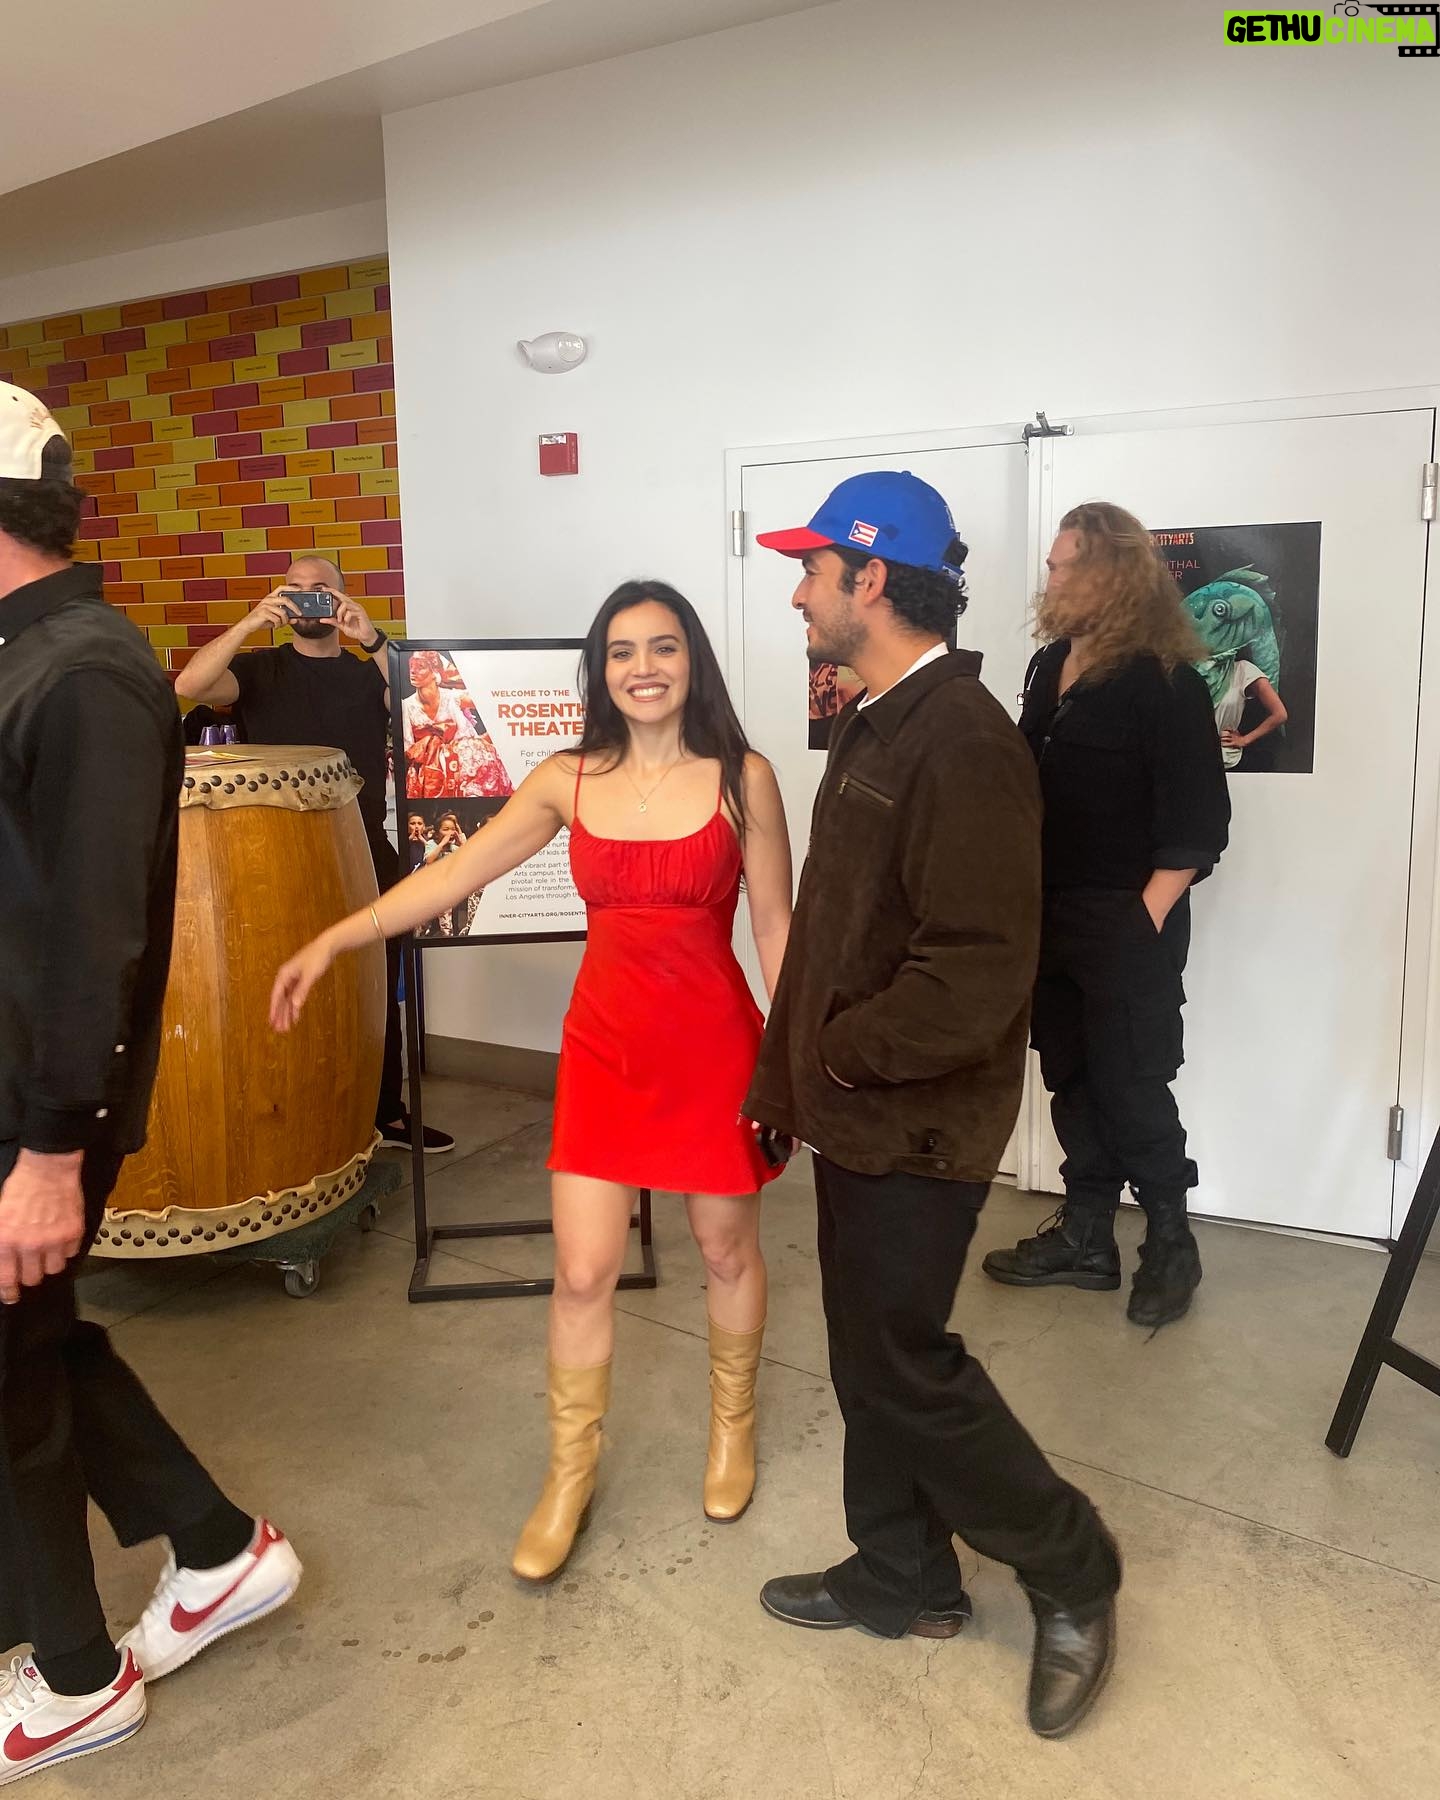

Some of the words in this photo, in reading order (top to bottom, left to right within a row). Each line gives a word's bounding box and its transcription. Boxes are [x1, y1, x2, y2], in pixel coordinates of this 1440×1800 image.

[491, 690, 536, 698] WELCOME
[553, 689, 570, 697] THE
[507, 721, 584, 736] THEATE
[548, 862, 561, 870] part
[519, 892, 545, 900] Angeles
[546, 890, 571, 898] through
